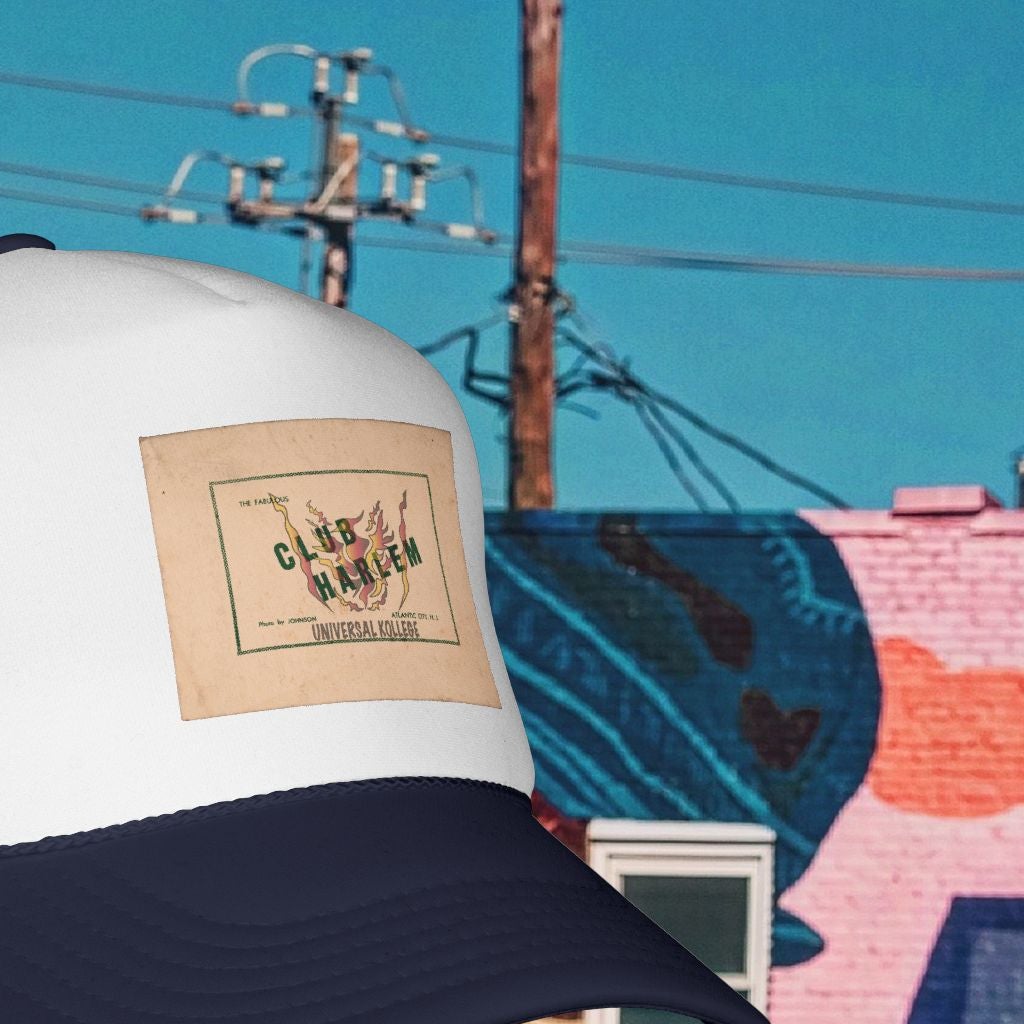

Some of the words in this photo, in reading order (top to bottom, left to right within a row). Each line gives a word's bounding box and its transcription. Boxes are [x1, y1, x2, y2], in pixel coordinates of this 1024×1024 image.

[238, 500, 251, 508] THE
[273, 517, 356, 571] CLUB
[312, 536, 423, 602] HARLEM
[288, 616, 318, 625] JOHNSON
[311, 620, 378, 641] UNIVERSAL
[377, 619, 420, 638] KOLLEGE
